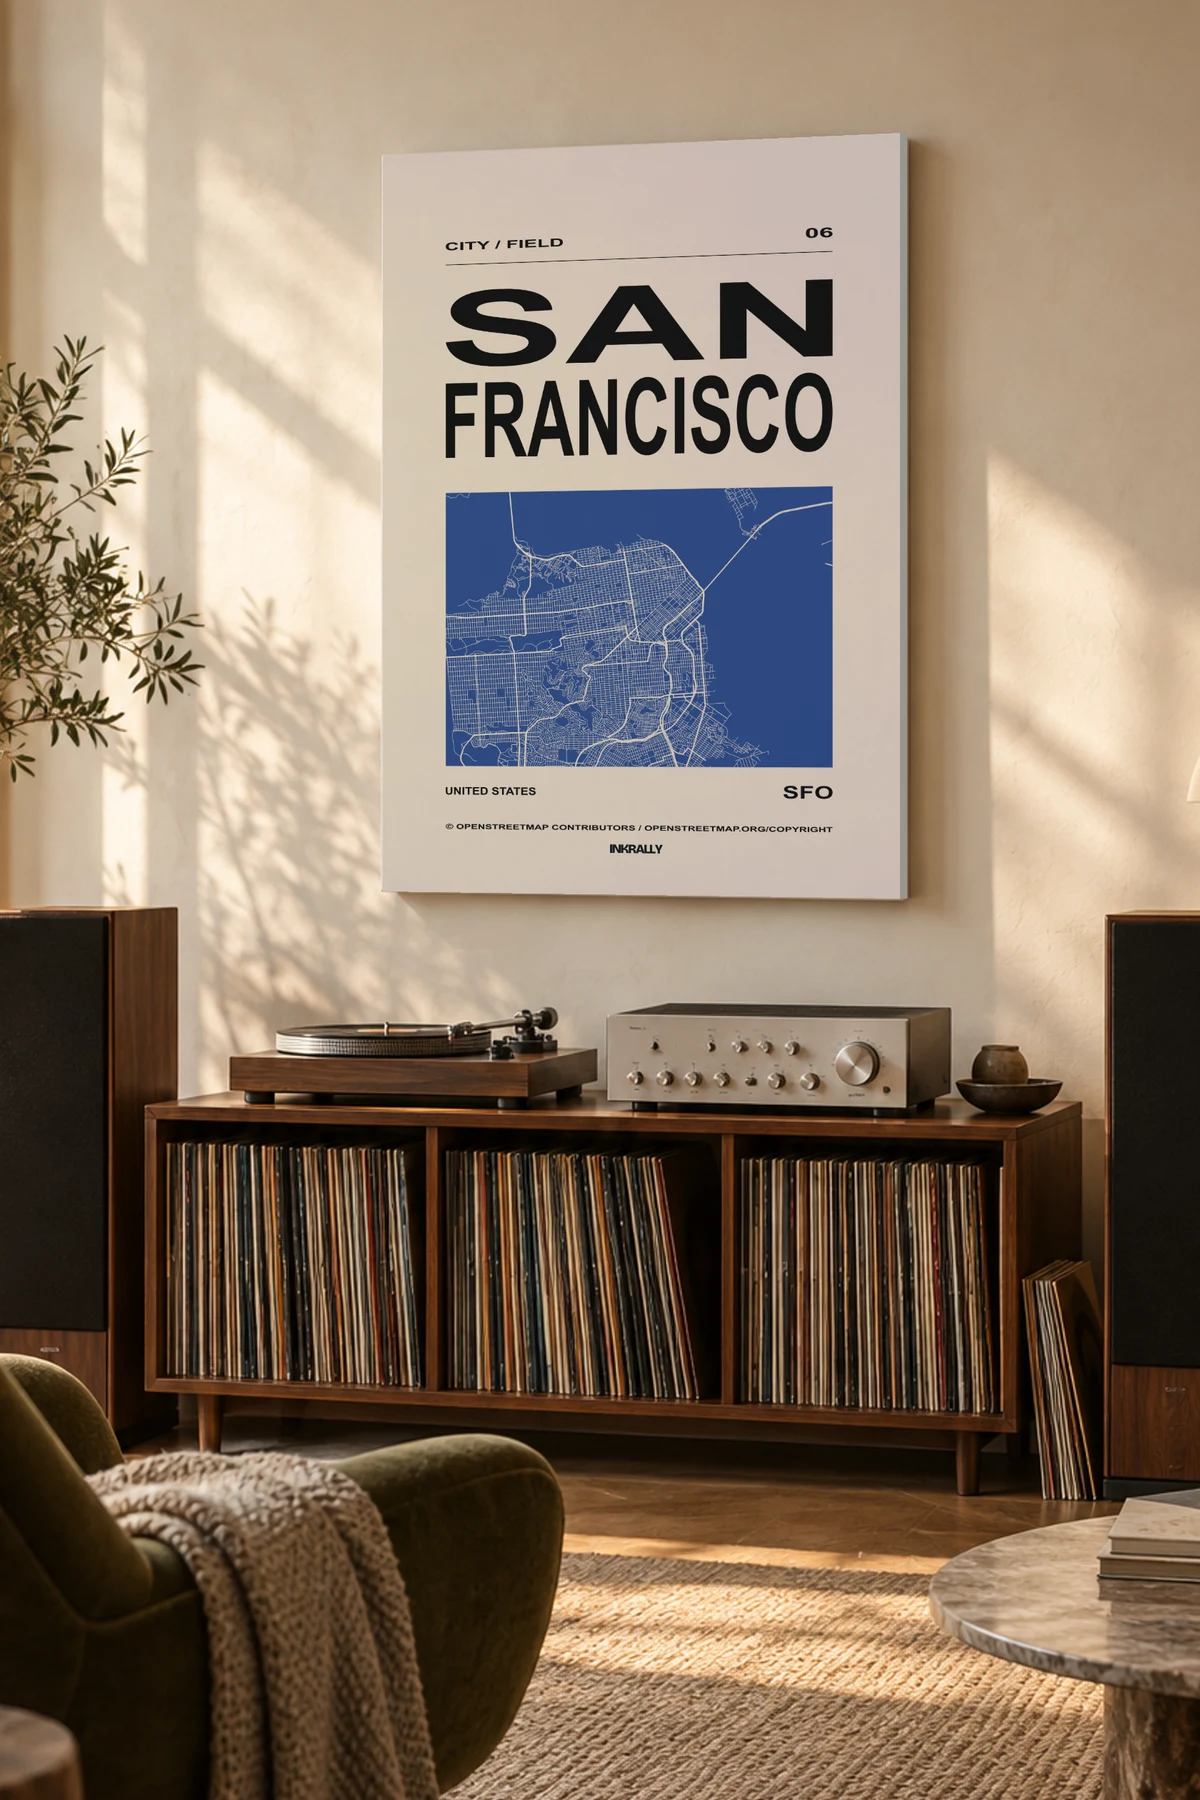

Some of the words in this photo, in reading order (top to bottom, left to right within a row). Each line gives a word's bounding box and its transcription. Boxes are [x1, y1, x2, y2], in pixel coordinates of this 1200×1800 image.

[805, 226, 834, 239] 06
[445, 241, 490, 251] CITY
[495, 240, 501, 250] /
[506, 237, 564, 249] FIELD
[445, 278, 834, 367] SAN
[445, 372, 834, 459] FRANCISCO
[445, 786, 489, 796] UNITED
[491, 786, 537, 796] STATES
[783, 785, 834, 800] SFO
[456, 823, 550, 831] OPENSTREETMAP
[551, 824, 636, 832] CONTRIBUTORS
[644, 825, 834, 833] OPENSTREETMAP.ORG/COPYRIGHT
[609, 843, 664, 855] INKRALLY
